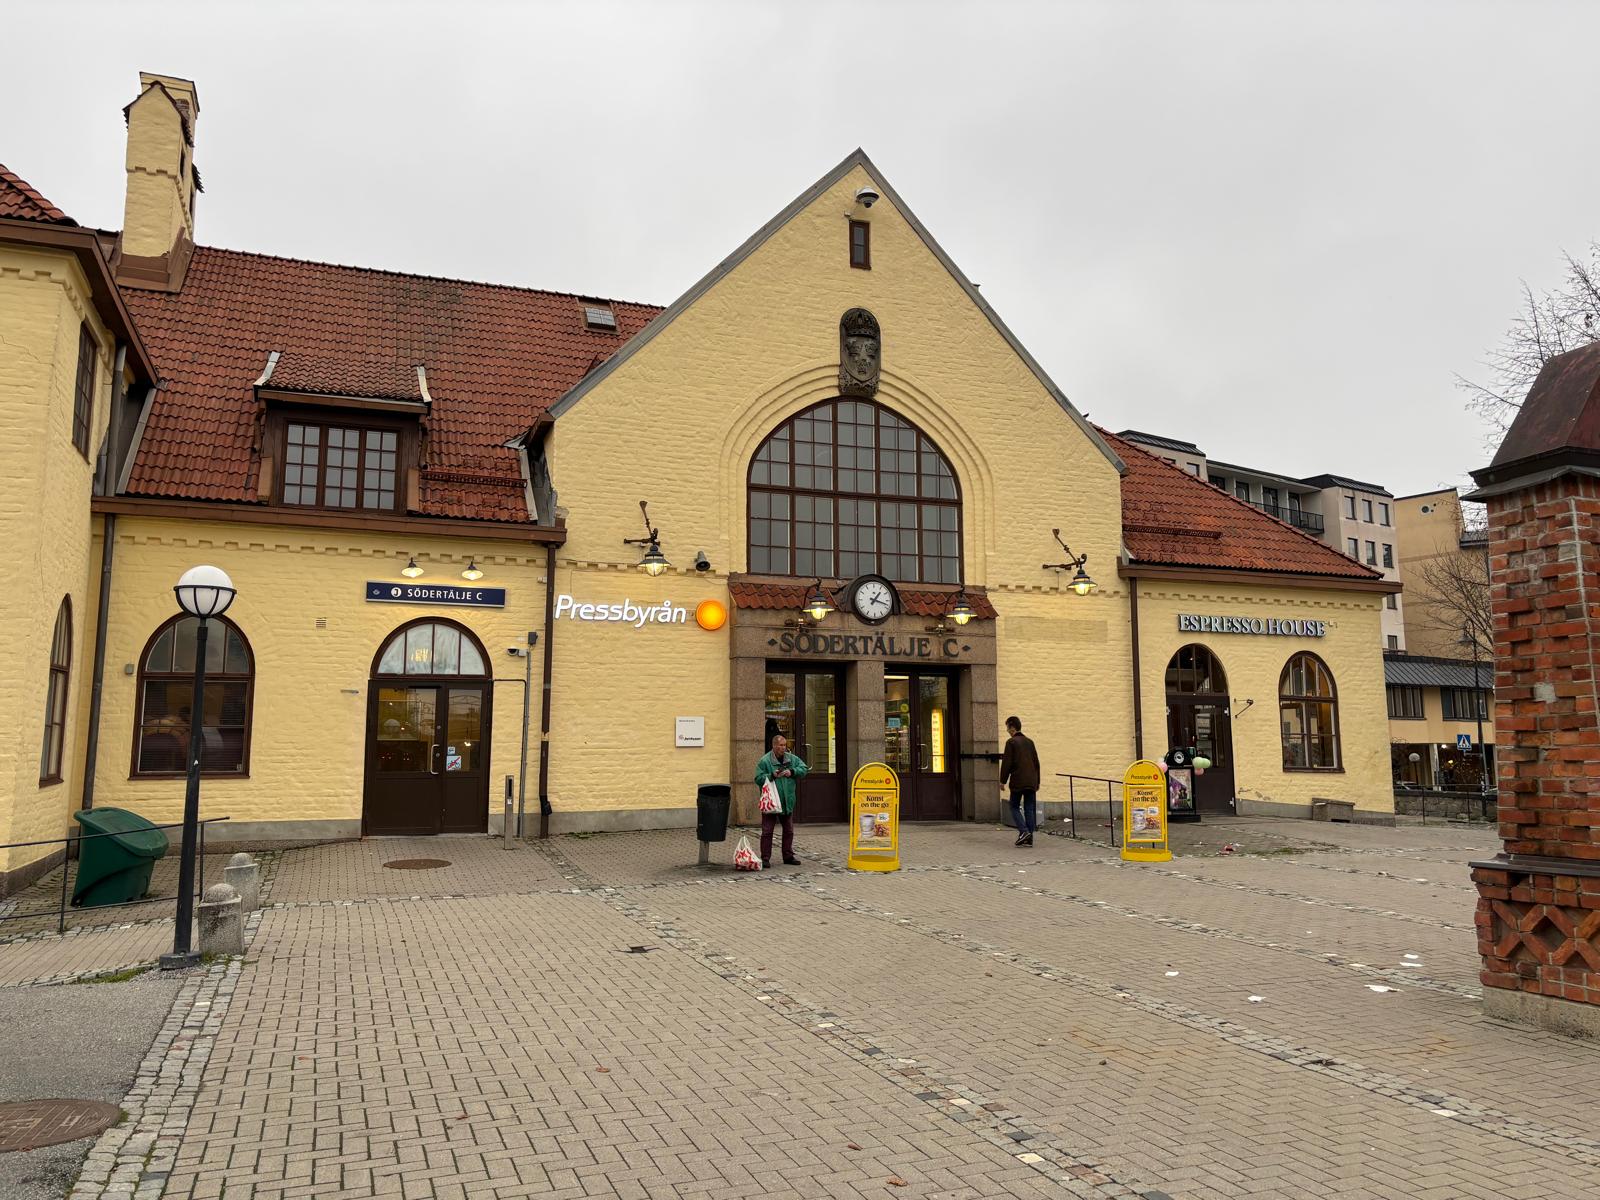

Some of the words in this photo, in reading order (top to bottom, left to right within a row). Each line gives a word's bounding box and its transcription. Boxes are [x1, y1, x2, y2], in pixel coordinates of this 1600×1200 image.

[407, 588, 472, 600] SÖDERTÄLJE
[476, 592, 483, 601] C
[554, 594, 687, 628] Pressbyrån
[1179, 614, 1263, 634] ESPRESSO
[1267, 618, 1326, 637] HOUSE
[779, 631, 931, 657] SÖDERTÄLJE
[942, 638, 960, 657] C
